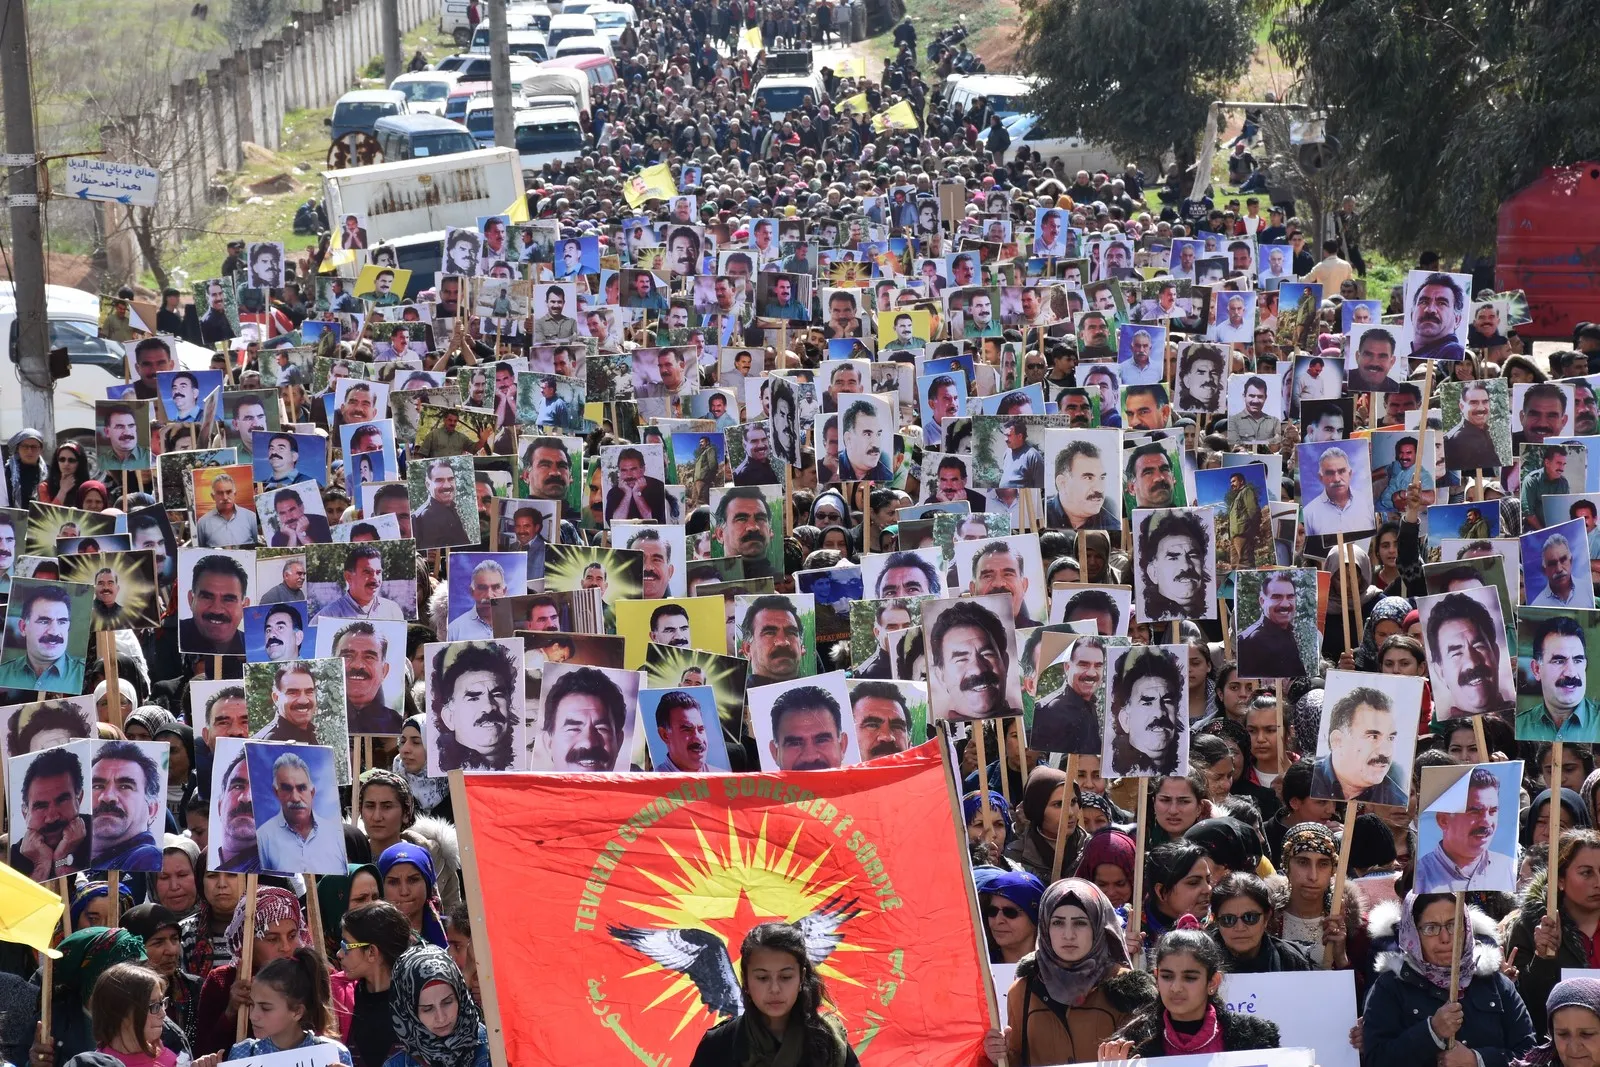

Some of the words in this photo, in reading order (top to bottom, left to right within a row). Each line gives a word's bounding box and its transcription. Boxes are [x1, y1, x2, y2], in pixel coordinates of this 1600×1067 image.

[134, 168, 155, 179] معالج
[120, 182, 142, 191] محمد
[574, 840, 626, 932] TEVGERA
